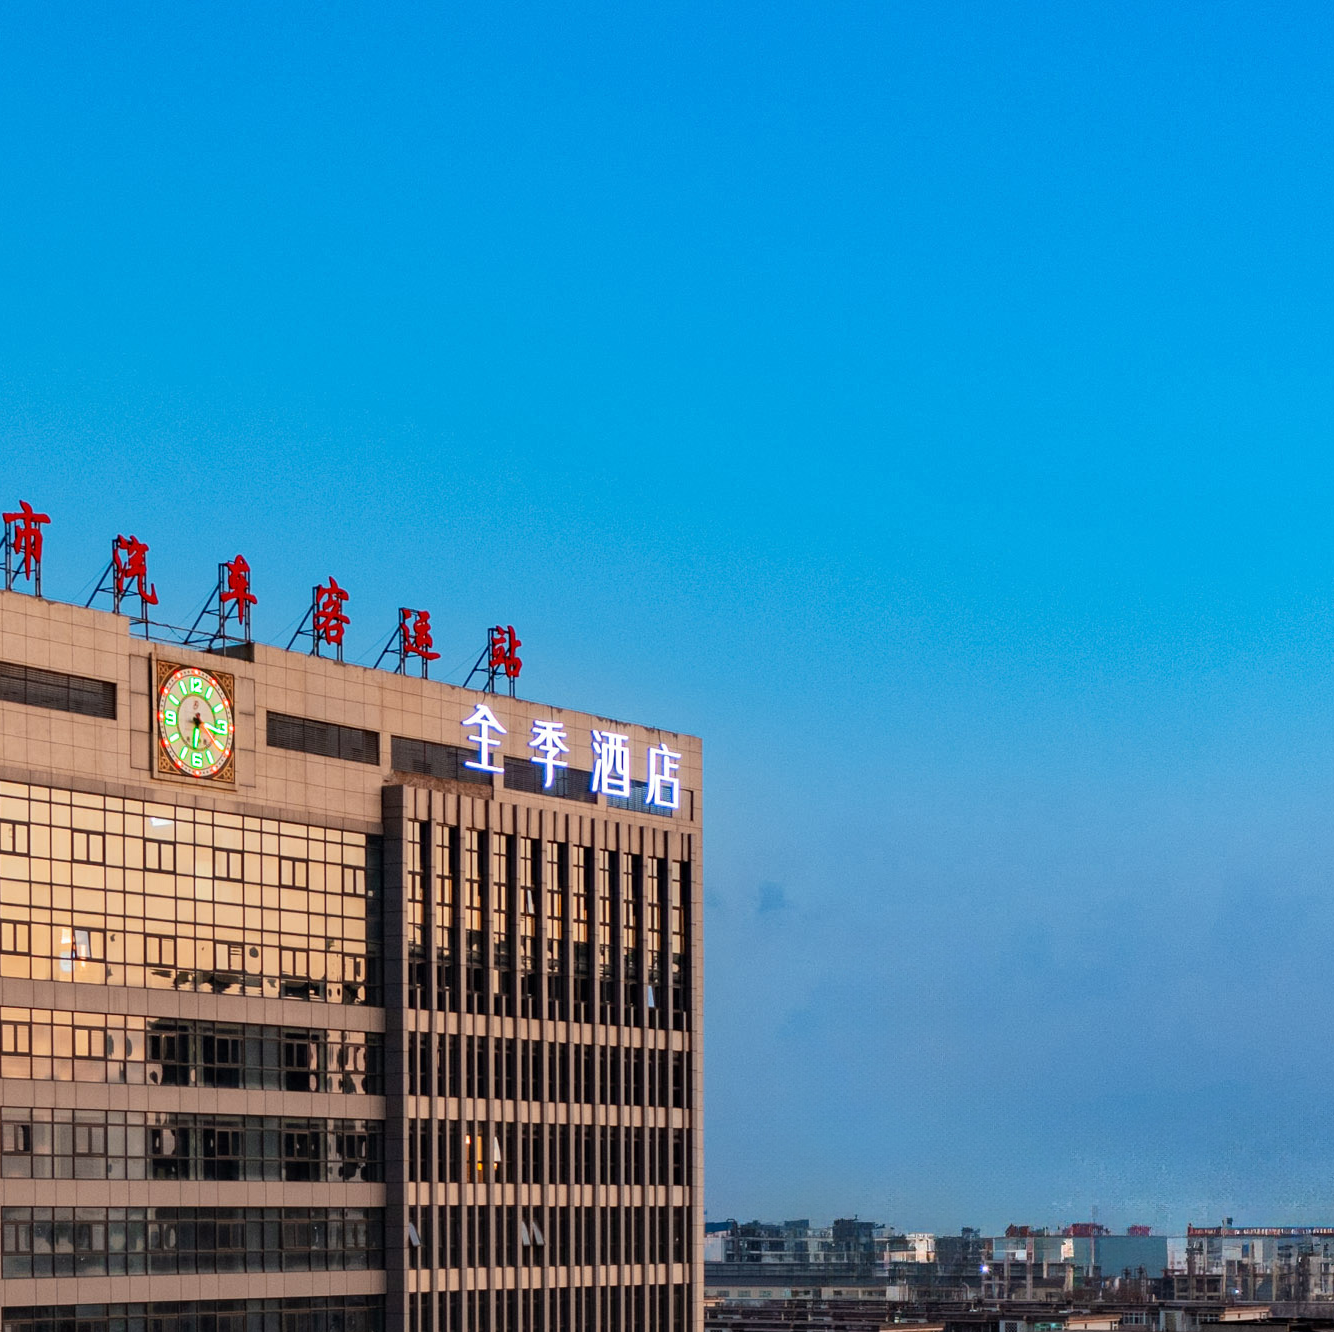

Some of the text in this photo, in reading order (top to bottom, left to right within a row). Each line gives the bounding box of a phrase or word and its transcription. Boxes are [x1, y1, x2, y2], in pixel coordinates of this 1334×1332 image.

[190, 677, 203, 693] 12
[164, 710, 177, 726] 9
[191, 752, 203, 768] 6
[462, 703, 682, 809] 全季酒店
